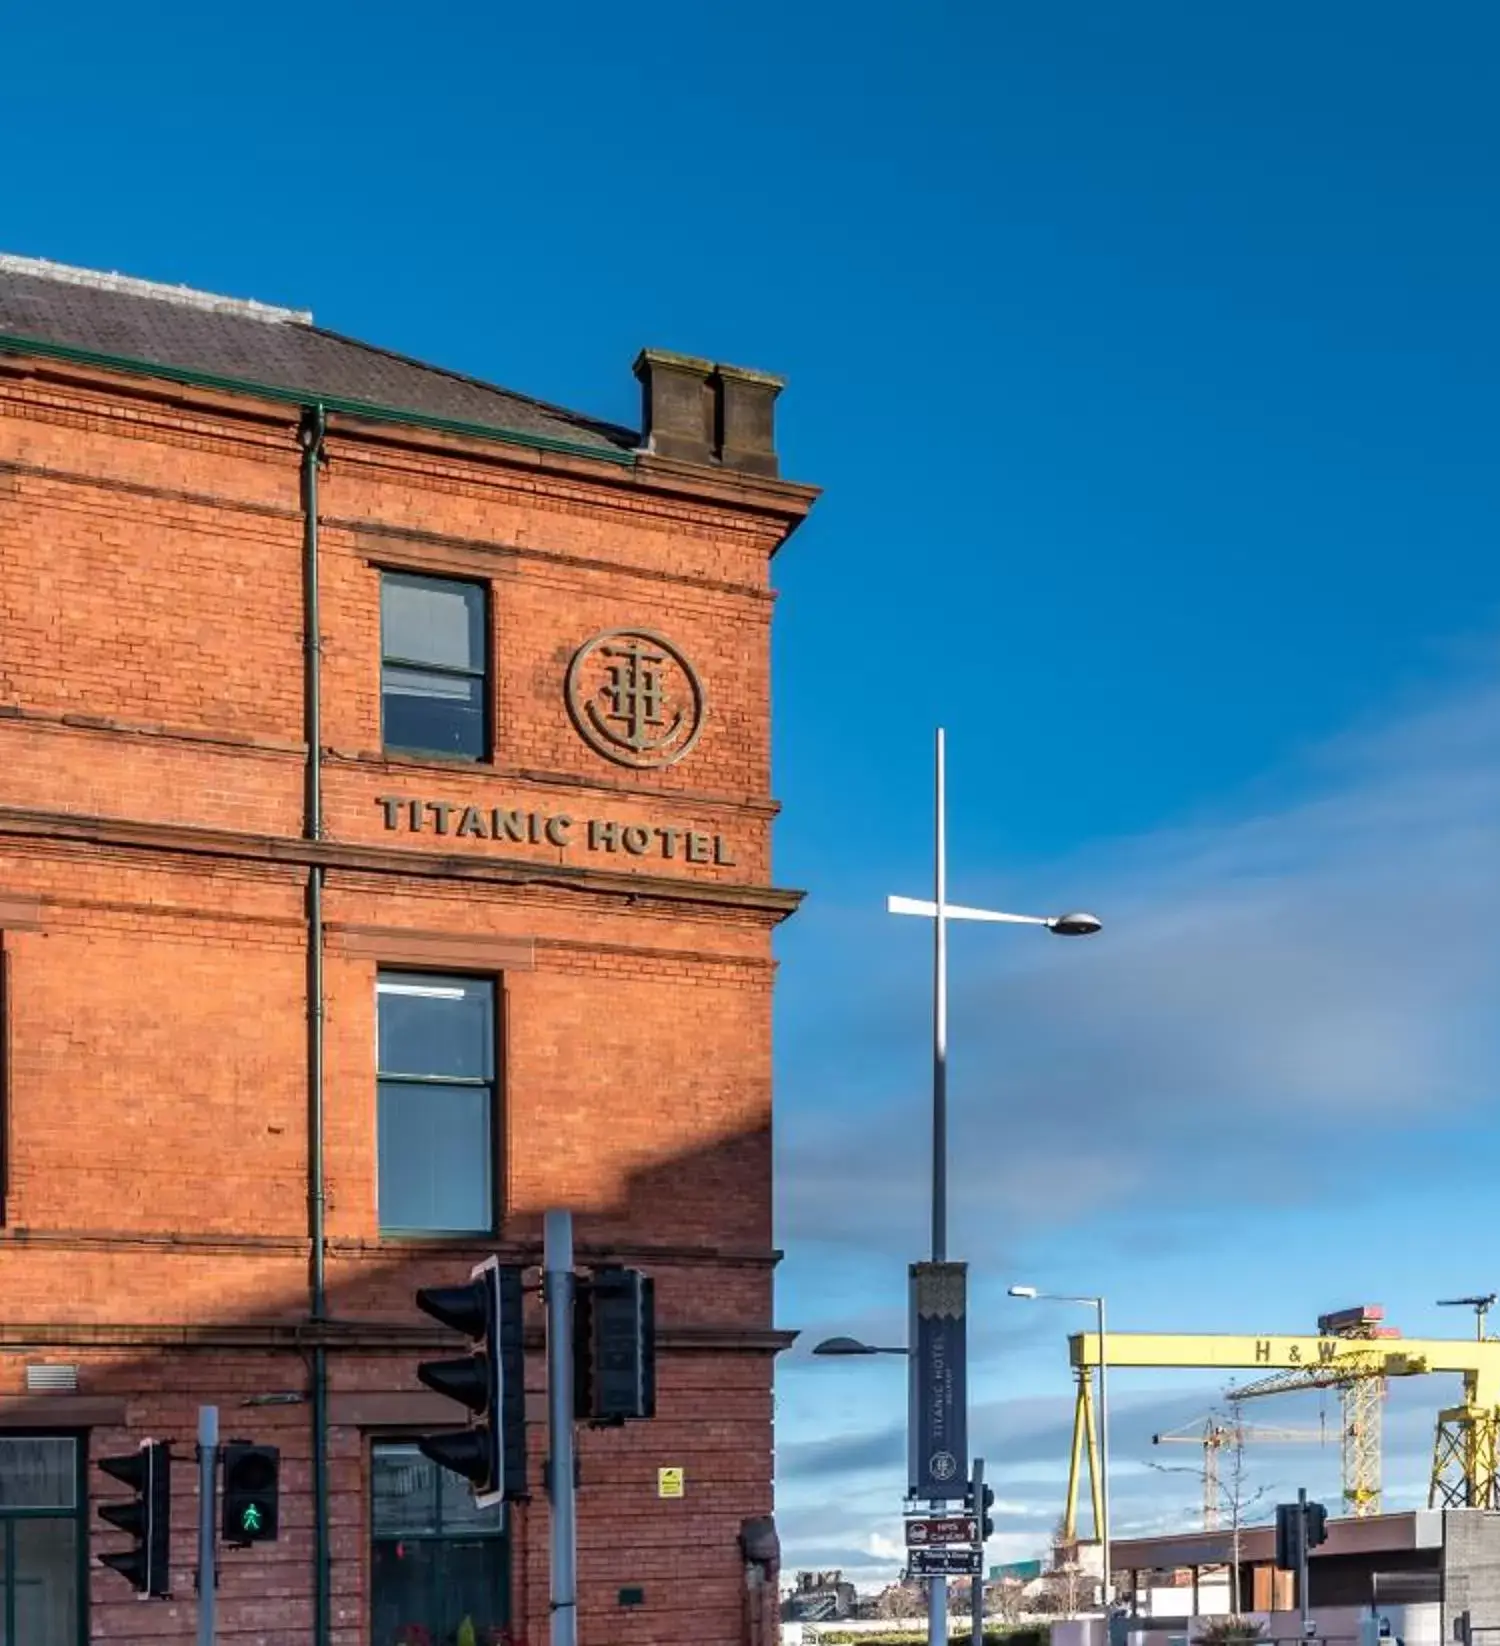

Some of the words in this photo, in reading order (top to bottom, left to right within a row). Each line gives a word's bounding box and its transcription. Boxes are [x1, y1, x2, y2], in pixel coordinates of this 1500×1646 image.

[375, 796, 573, 846] TITANIC
[587, 819, 736, 866] HOTEL
[933, 1334, 945, 1379] HOTEL
[1256, 1340, 1270, 1361] H
[1289, 1345, 1301, 1362] &
[1318, 1341, 1336, 1362] W
[933, 1385, 943, 1439] TITANIC
